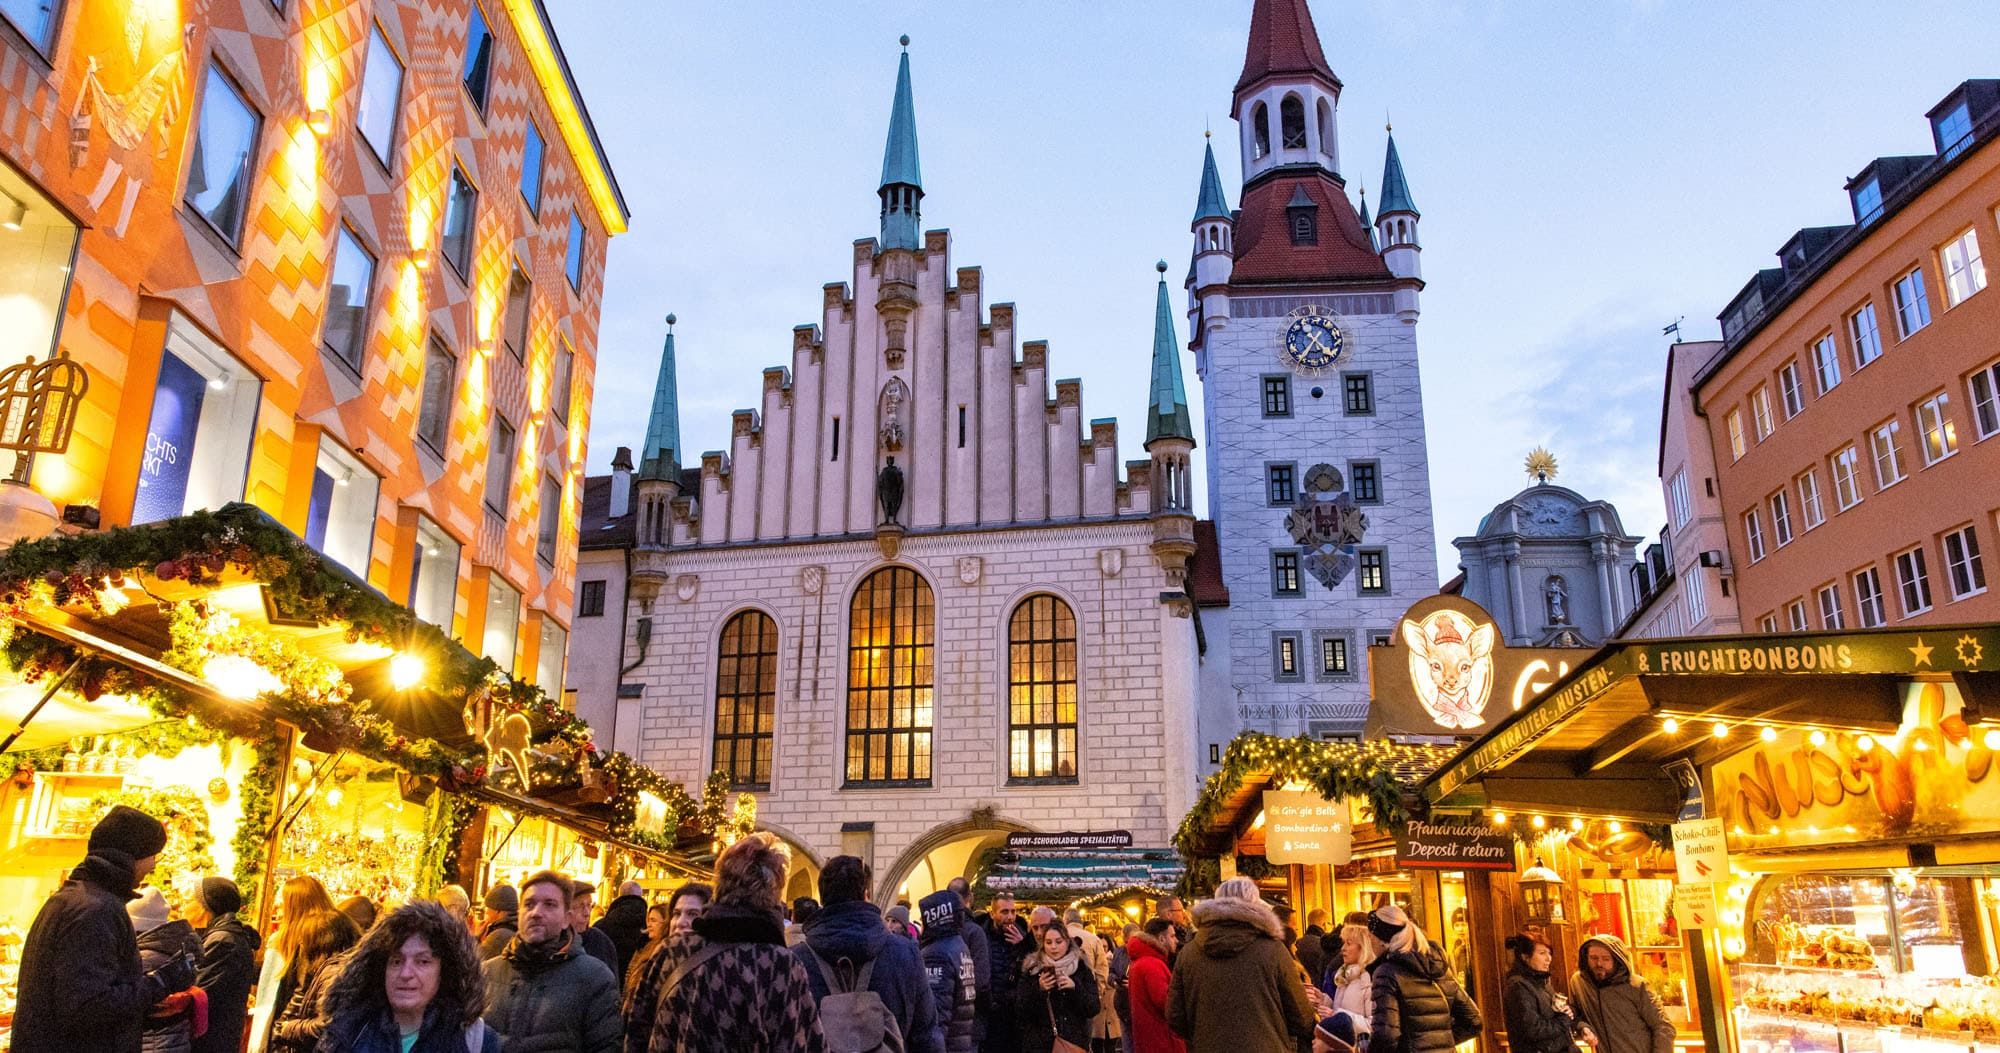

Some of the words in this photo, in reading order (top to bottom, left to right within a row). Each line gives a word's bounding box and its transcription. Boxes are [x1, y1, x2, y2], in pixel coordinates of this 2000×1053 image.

[1639, 652, 1650, 671] &
[1661, 645, 1852, 672] FRUCHTBONBONS
[1473, 743, 1499, 770] PIT'S
[1315, 806, 1337, 816] Bells
[1274, 823, 1329, 833] Bombardino
[1010, 837, 1079, 846] CANDY-SCHOKOLADEN
[1080, 834, 1129, 845] SPEZIALITÄTEN
[1294, 841, 1321, 850] Santa
[1406, 841, 1459, 860] Deposit
[1462, 842, 1506, 858] return
[1685, 844, 1715, 856] Bonbons
[924, 902, 953, 924] 25/01
